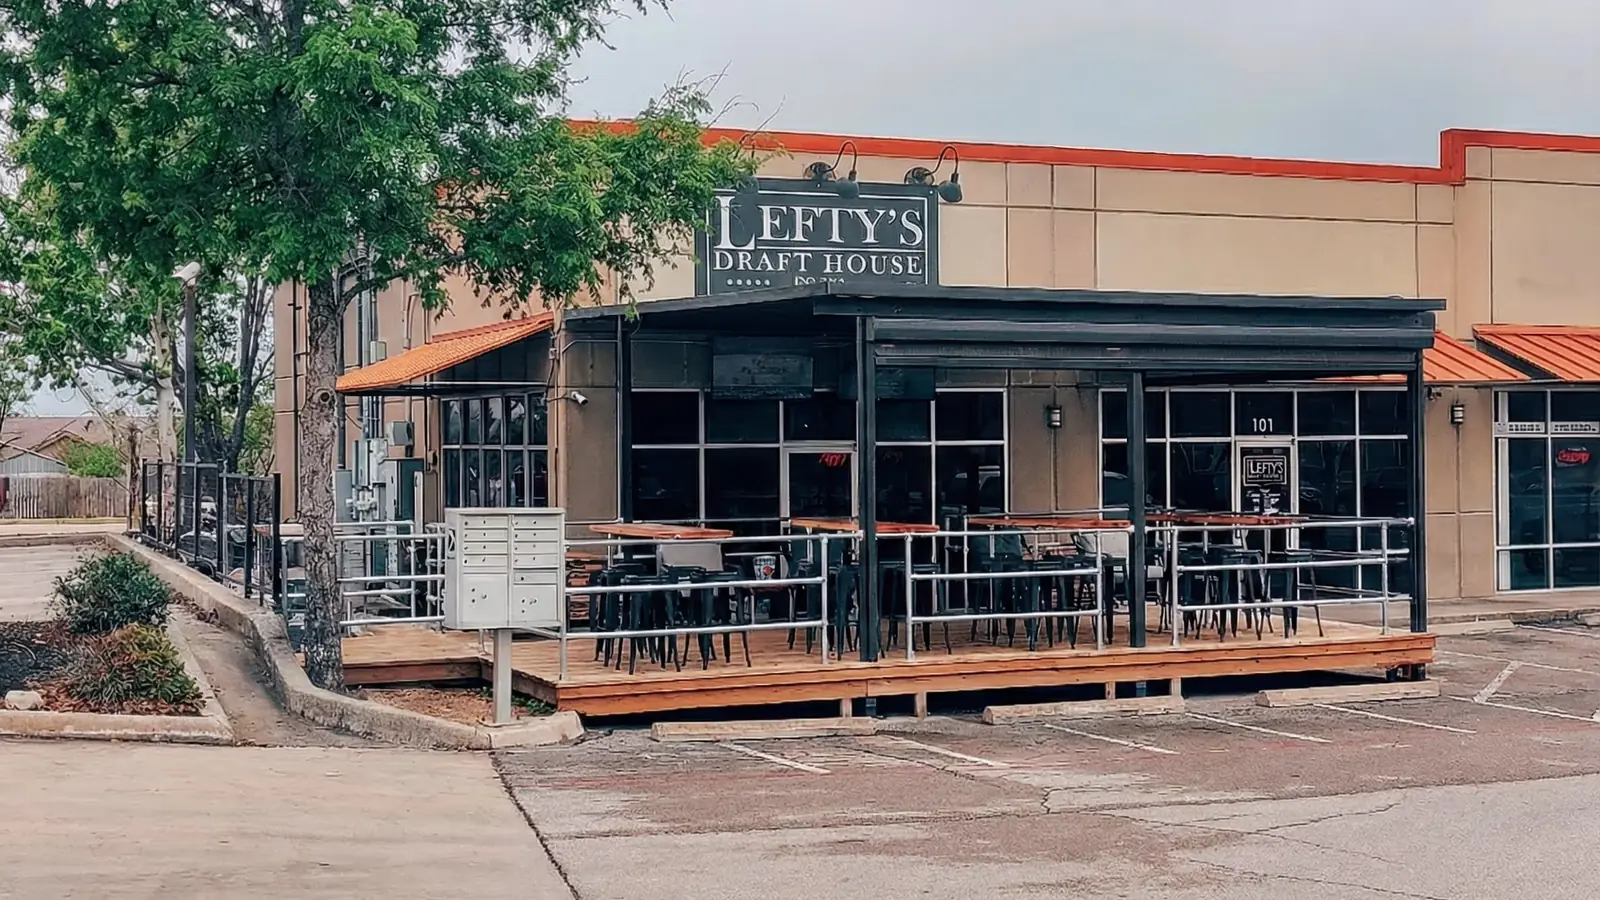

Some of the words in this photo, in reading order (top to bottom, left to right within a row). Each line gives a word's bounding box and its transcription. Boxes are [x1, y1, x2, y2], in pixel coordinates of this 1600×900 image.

[714, 196, 923, 250] LEFTY'S
[713, 251, 813, 271] DRAFT
[823, 254, 922, 275] HOUSE
[1252, 418, 1273, 432] 101
